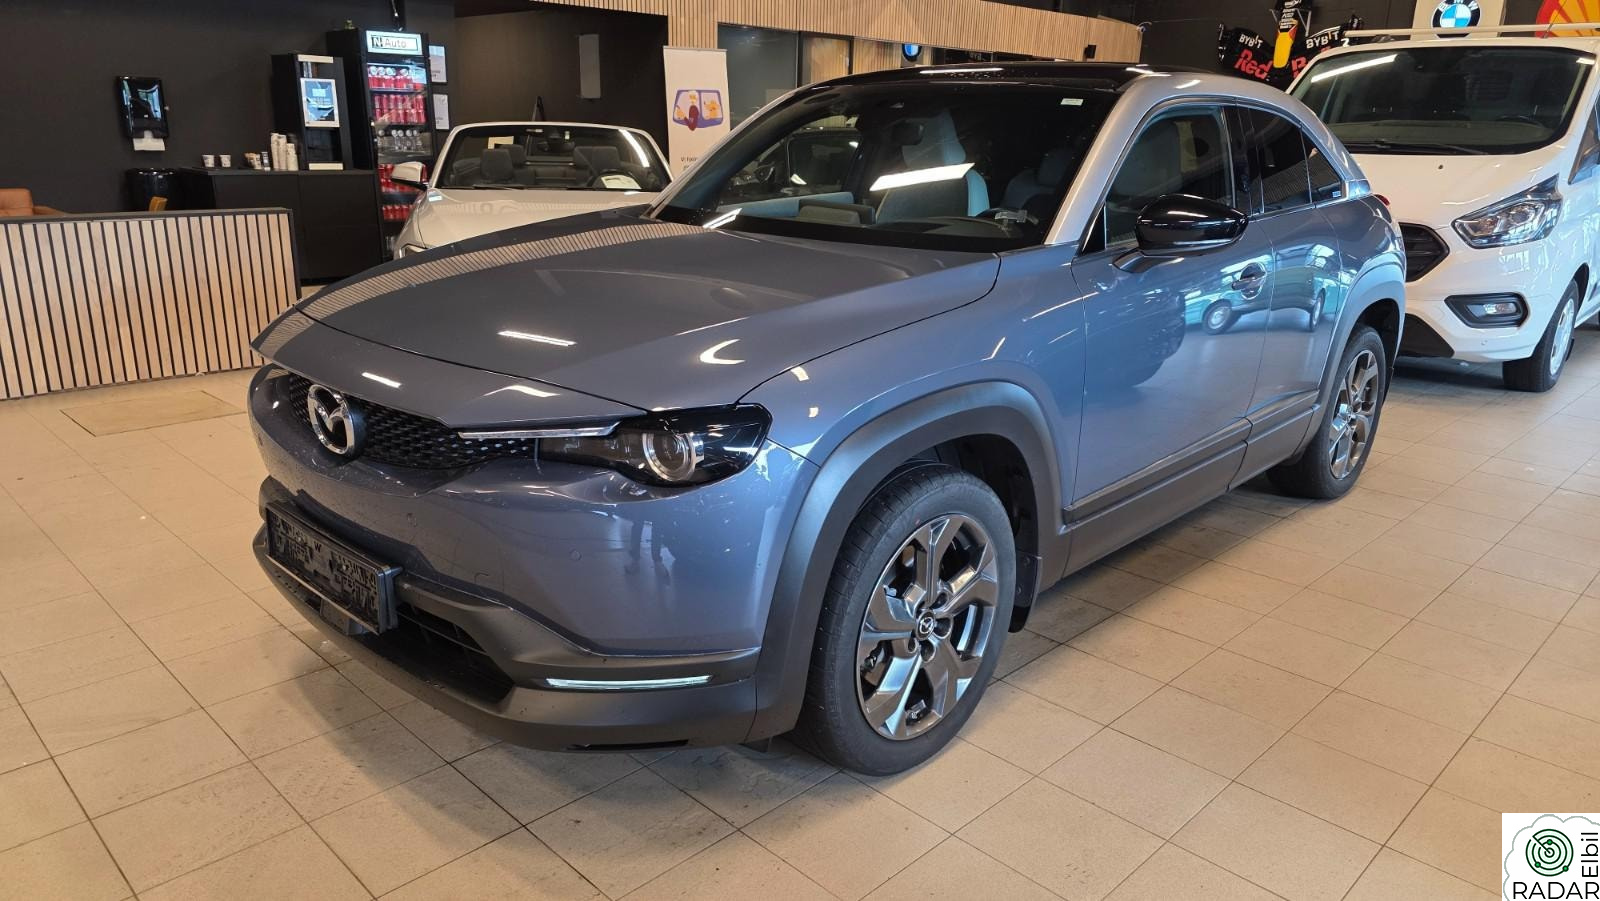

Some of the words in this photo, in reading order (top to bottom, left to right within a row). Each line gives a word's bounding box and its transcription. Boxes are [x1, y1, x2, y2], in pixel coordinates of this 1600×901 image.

[384, 38, 407, 48] Auto
[1239, 33, 1263, 49] BYBIT
[1306, 30, 1340, 49] BYBIT
[1233, 48, 1273, 79] Red
